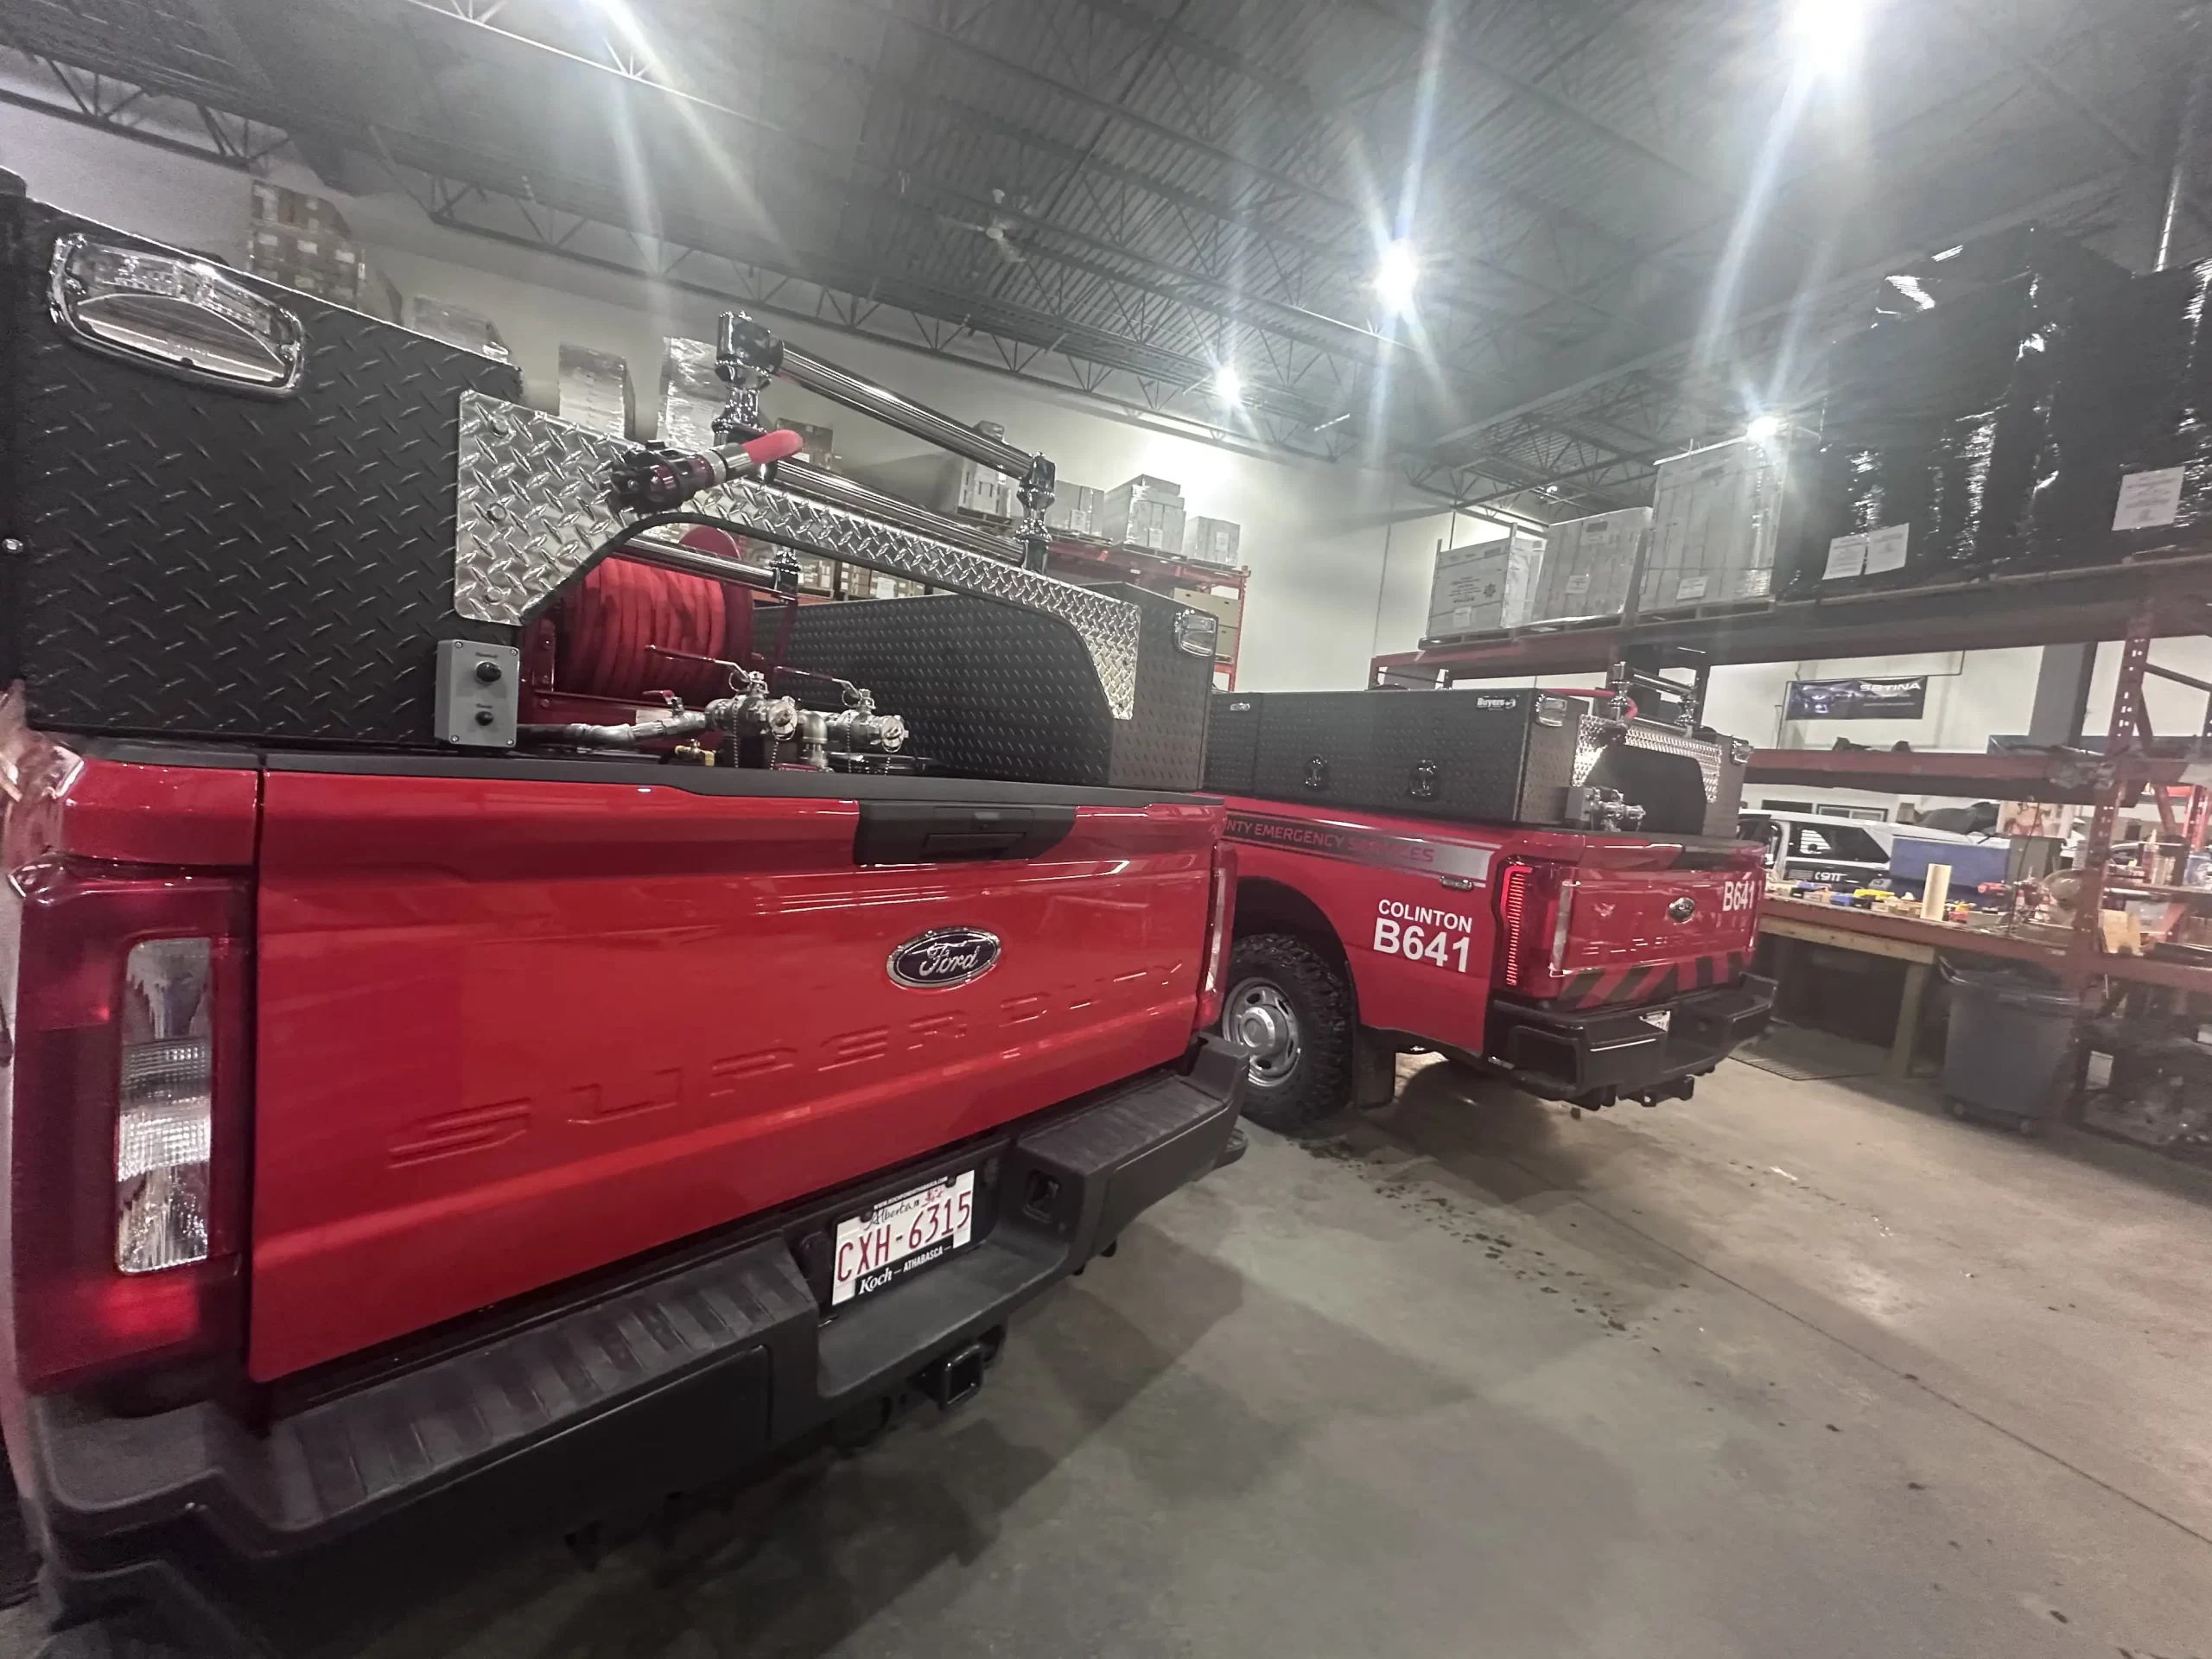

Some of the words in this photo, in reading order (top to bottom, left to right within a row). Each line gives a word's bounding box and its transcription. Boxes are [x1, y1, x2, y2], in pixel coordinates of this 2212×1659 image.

[1477, 697, 1504, 708] Buyers
[1859, 682, 1922, 691] SETINA
[1254, 823, 1345, 849] EMERGENCY
[1722, 880, 1755, 912] B641
[1378, 899, 1473, 934] COLINTON
[918, 941, 982, 976] Ford
[1373, 917, 1470, 973] B641
[388, 1009, 968, 1170] SUPER
[836, 1190, 972, 1282] CXH-6315
[858, 1267, 893, 1295] Koch
[903, 1245, 944, 1273] ATHABASCA
